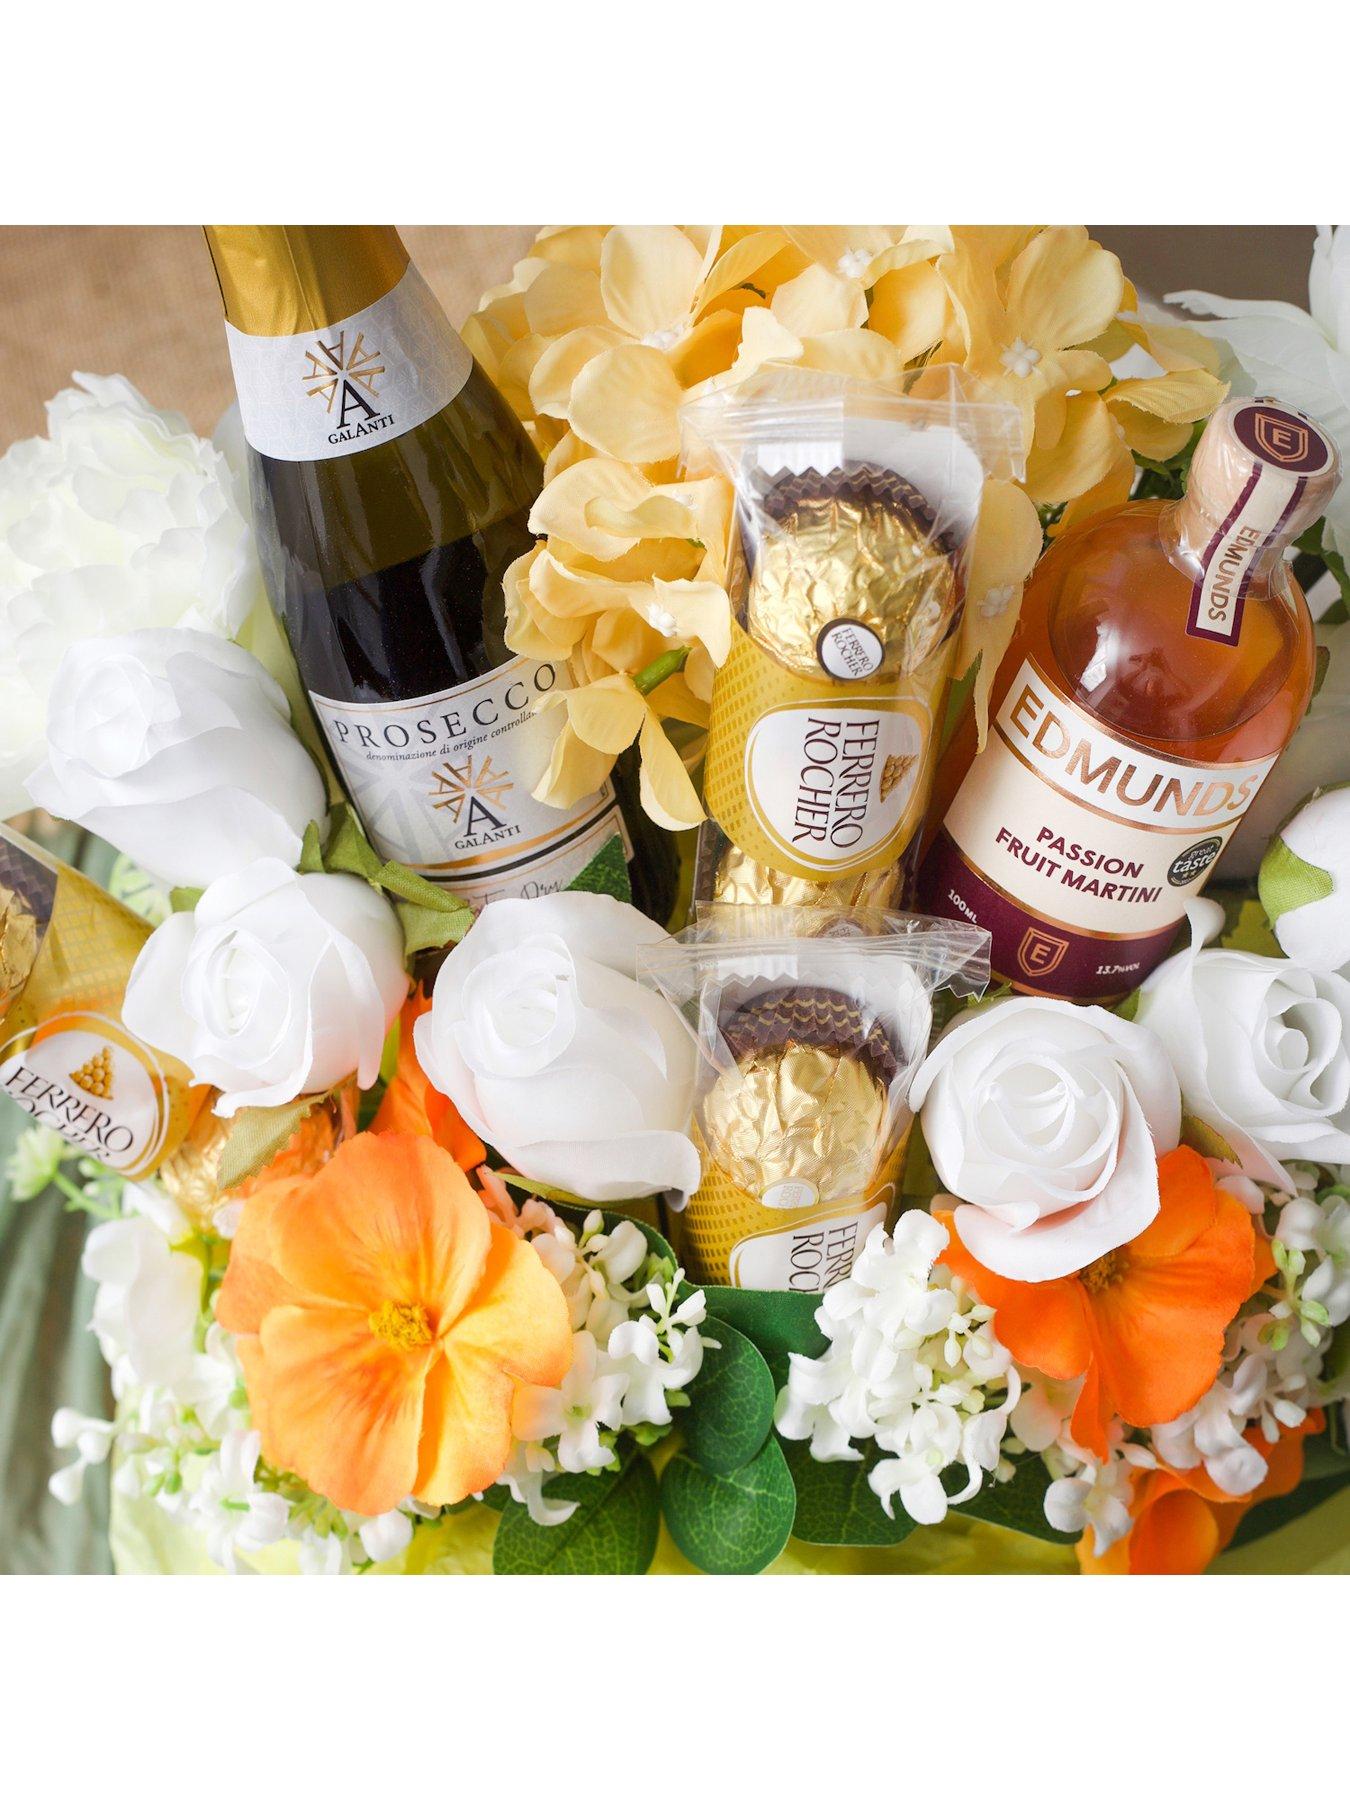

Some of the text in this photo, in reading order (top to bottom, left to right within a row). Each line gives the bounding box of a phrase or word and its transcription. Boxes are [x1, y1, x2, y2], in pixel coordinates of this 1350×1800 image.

[328, 413, 396, 445] GALANTI
[1272, 427, 1292, 450] E
[1208, 525, 1262, 623] EDMUNDS
[831, 632, 863, 676] ROCHER
[841, 627, 874, 671] FERRERO
[332, 663, 556, 749] PROSECCO
[366, 751, 437, 761] denominazione
[439, 743, 451, 755] di
[453, 734, 488, 750] origine
[1009, 684, 1258, 817] EDMUNDS
[792, 718, 841, 844] ROCHER
[830, 719, 880, 848] FERRERO
[454, 824, 521, 850] GALANTI
[1036, 827, 1144, 879] PASSION
[995, 827, 1163, 903] FRUIT MARTINI
[1172, 851, 1216, 873] taste
[948, 889, 977, 924] 100ML
[1031, 943, 1051, 965] E
[5, 1066, 134, 1153] FERRERO
[823, 1221, 858, 1289] FERR
